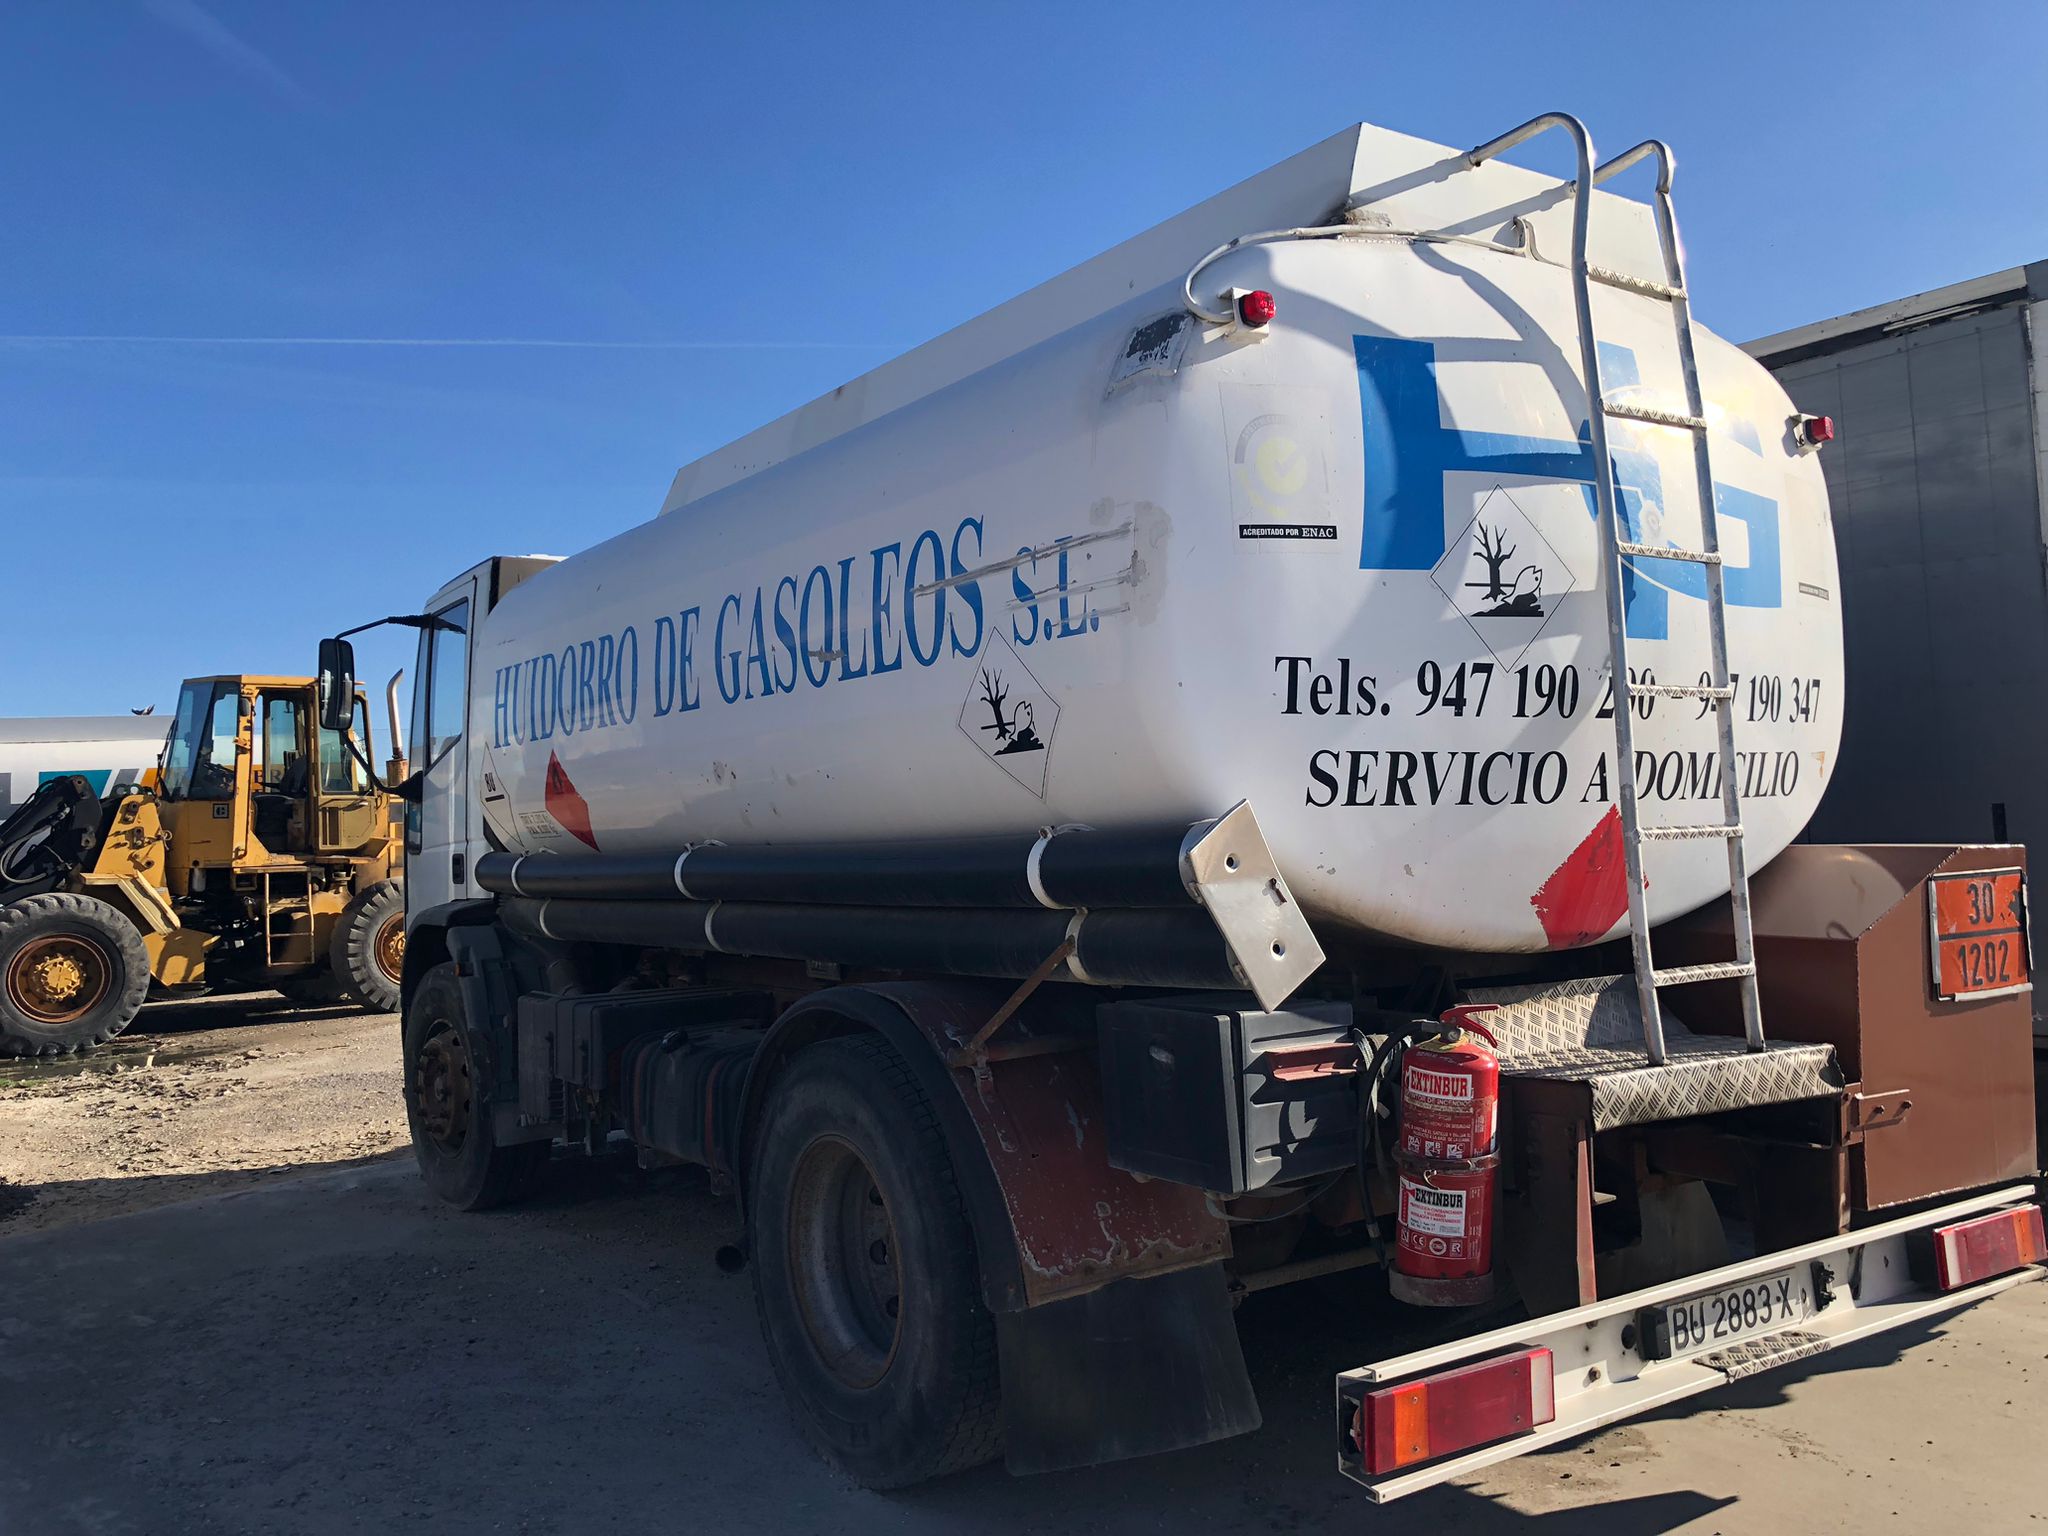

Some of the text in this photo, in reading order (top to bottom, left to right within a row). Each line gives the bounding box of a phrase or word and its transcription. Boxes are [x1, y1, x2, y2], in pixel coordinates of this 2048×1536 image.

[1242, 528, 1334, 538] ACREDITADO POR ENAC
[494, 515, 1100, 749] HUIDOBRO DE GASOLEOS S.L.
[1275, 656, 1391, 716] Tels.
[1415, 660, 1494, 718] 947
[1512, 664, 1579, 719] 190
[1695, 671, 1739, 721] 97
[1747, 674, 1781, 723] 190
[1789, 677, 1821, 723] 347
[1305, 749, 1568, 808] SERVICIO
[1580, 751, 1610, 803] A
[1967, 882, 1995, 925] 30
[1958, 939, 2010, 987] 1202
[1410, 1069, 1468, 1097] EXTINBUR
[1415, 1188, 1463, 1209] EXTINBUR
[1673, 1277, 1794, 1351] BU 2883 X
